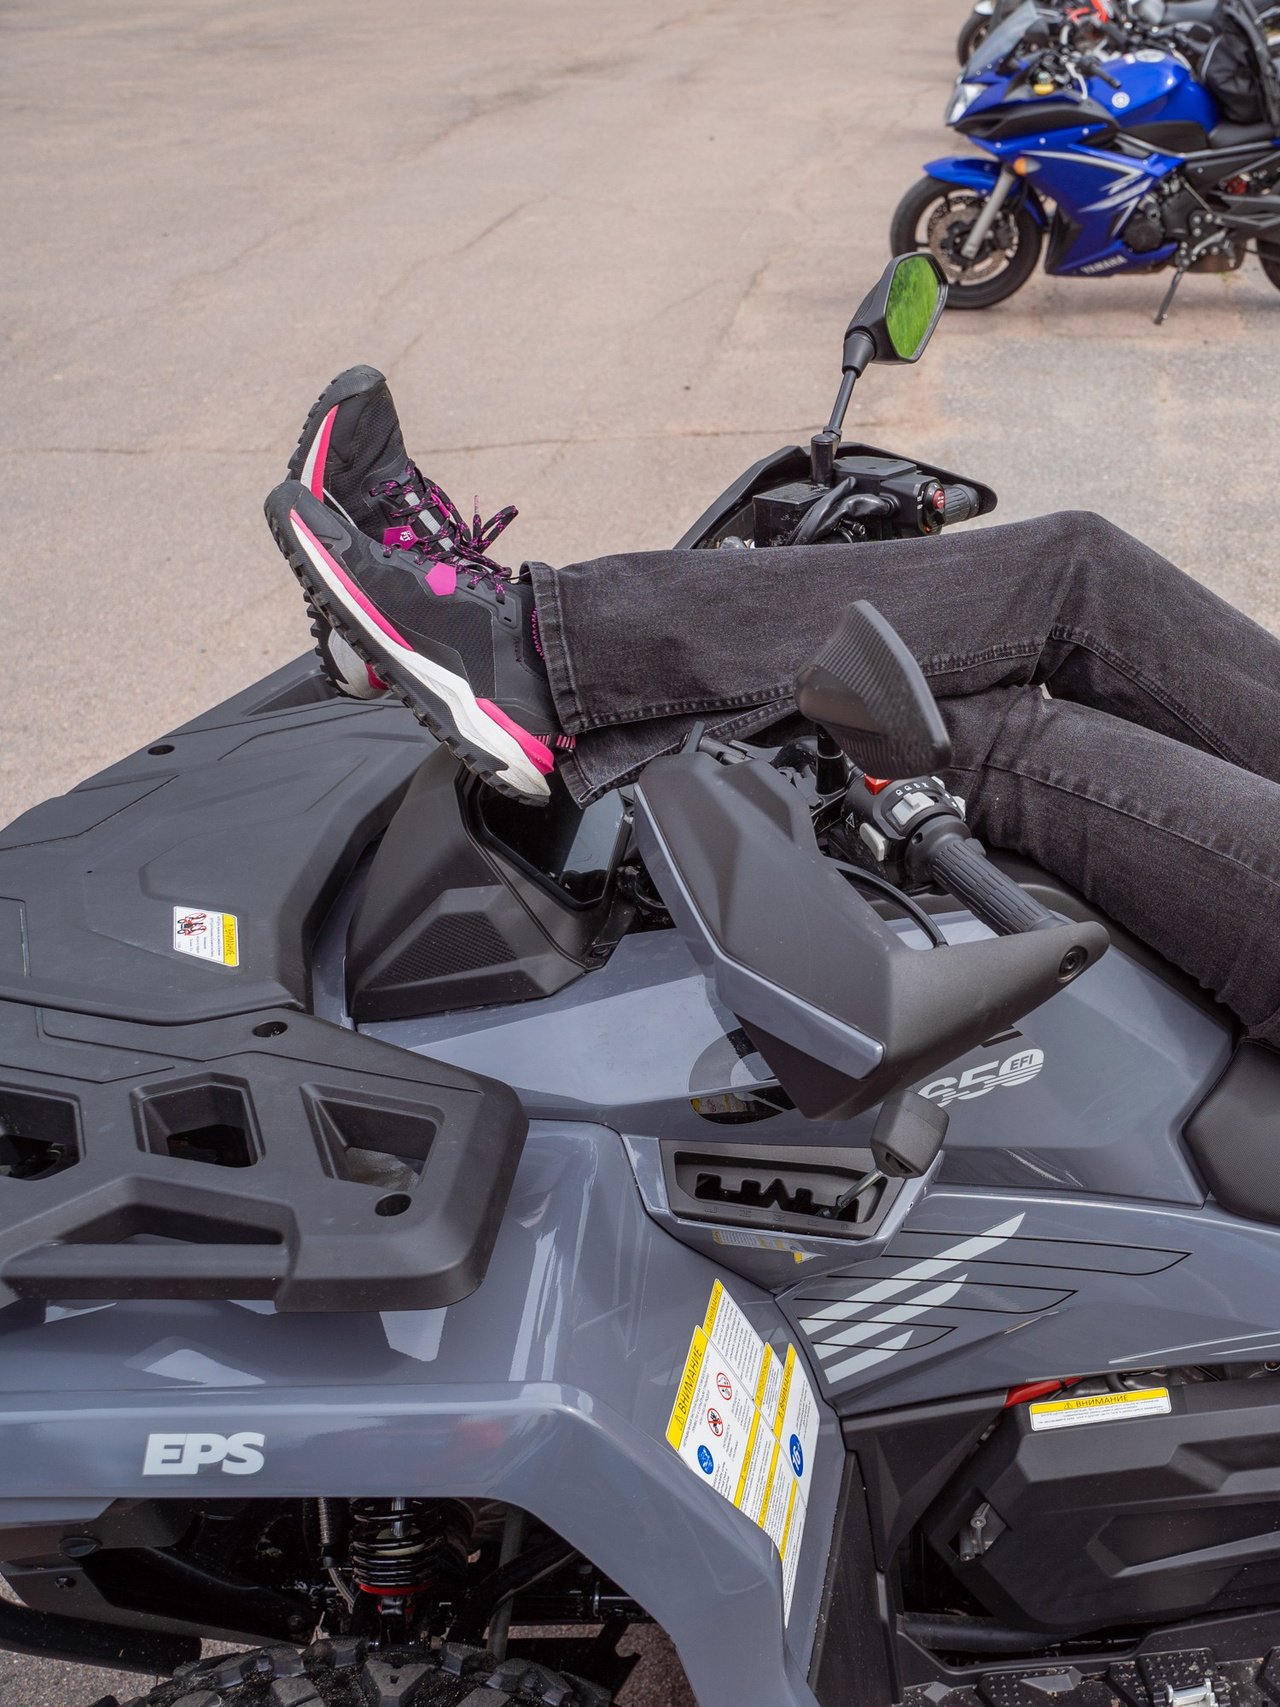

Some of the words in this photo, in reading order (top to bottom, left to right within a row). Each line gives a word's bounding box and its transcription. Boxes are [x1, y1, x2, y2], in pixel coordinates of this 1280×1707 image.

[1080, 254, 1128, 274] YAMAHA
[918, 1049, 1044, 1108] 650
[1010, 1054, 1034, 1071] EFI
[678, 1345, 703, 1415] ВНИМАНИЕ
[1075, 1395, 1128, 1408] ВНИМАНИЕ
[142, 1431, 265, 1475] EPS
